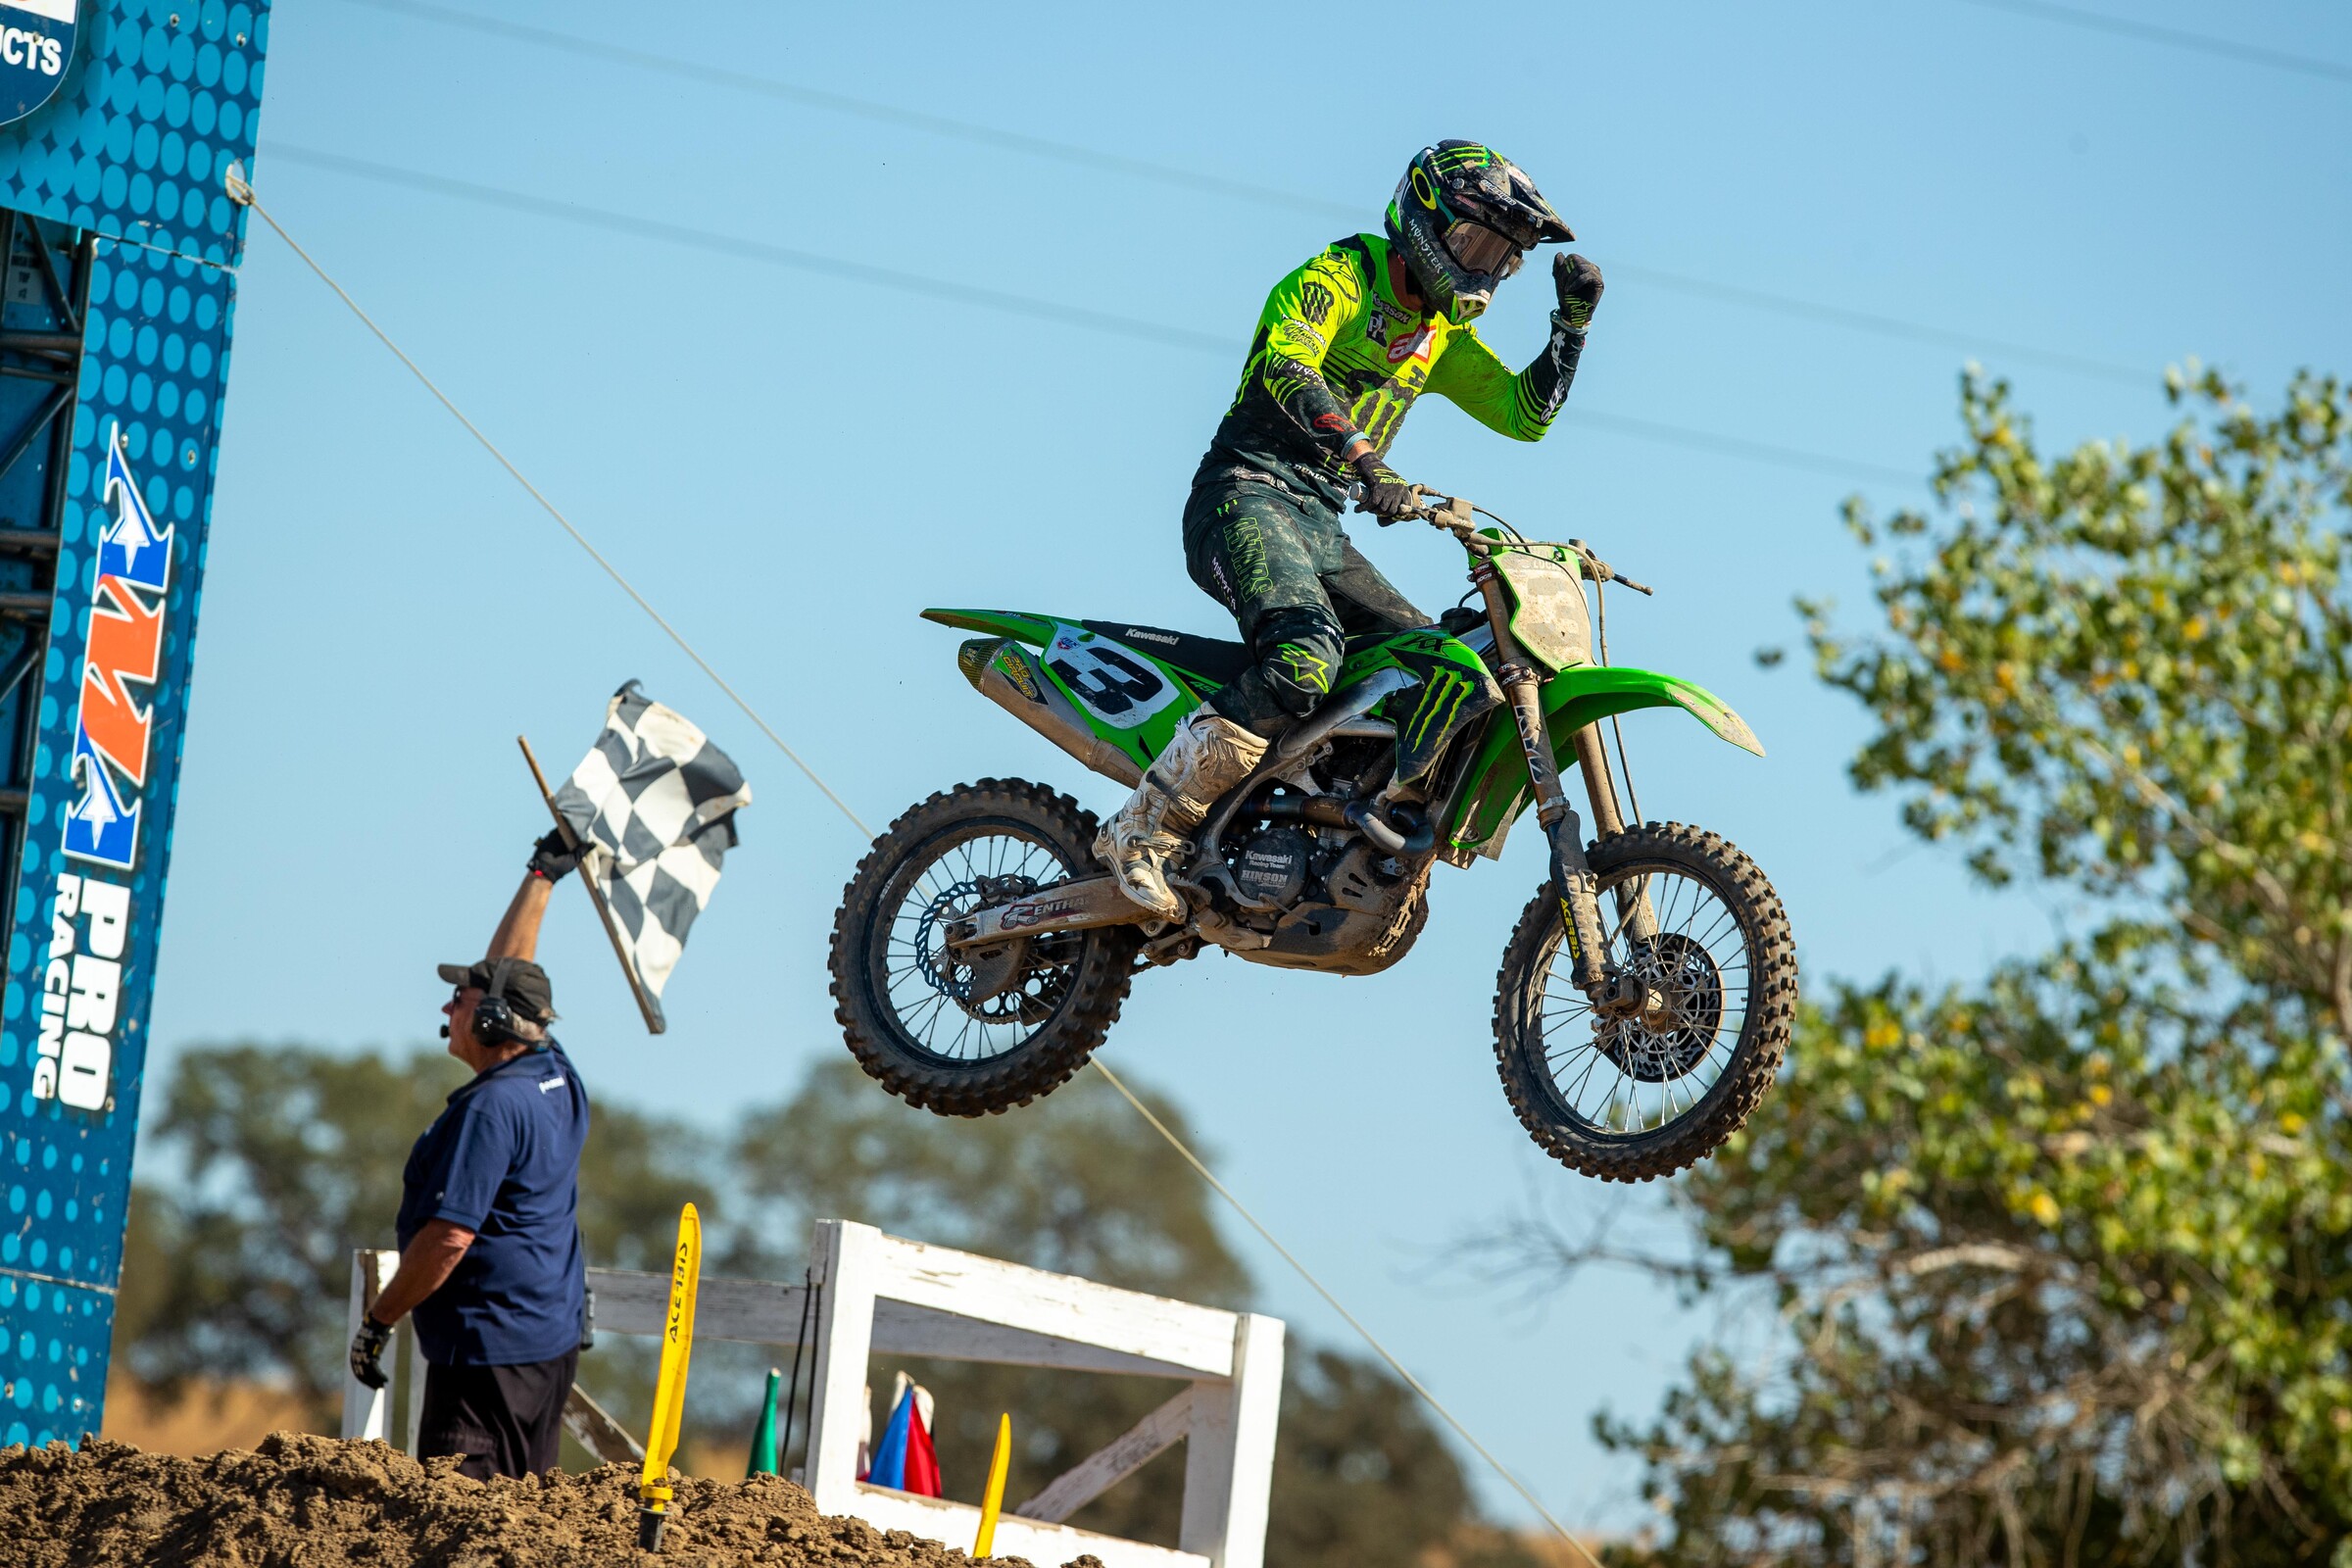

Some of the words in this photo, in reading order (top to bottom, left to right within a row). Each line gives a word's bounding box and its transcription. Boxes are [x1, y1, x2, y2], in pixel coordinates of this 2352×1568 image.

[0, 24, 62, 75] CTS
[1408, 219, 1444, 273] MONSTER
[1222, 516, 1274, 604] ASTARS
[1126, 627, 1180, 646] Kawasaki
[1003, 656, 1035, 699] CIRCUIT
[1012, 656, 1032, 679] PRO
[1049, 646, 1163, 715] 3
[1241, 869, 1289, 883] HINSON
[1245, 850, 1293, 864] Kawasaki
[1559, 897, 1581, 960] ACERBIS
[30, 872, 80, 1102] RACING
[57, 879, 131, 1110] PRO
